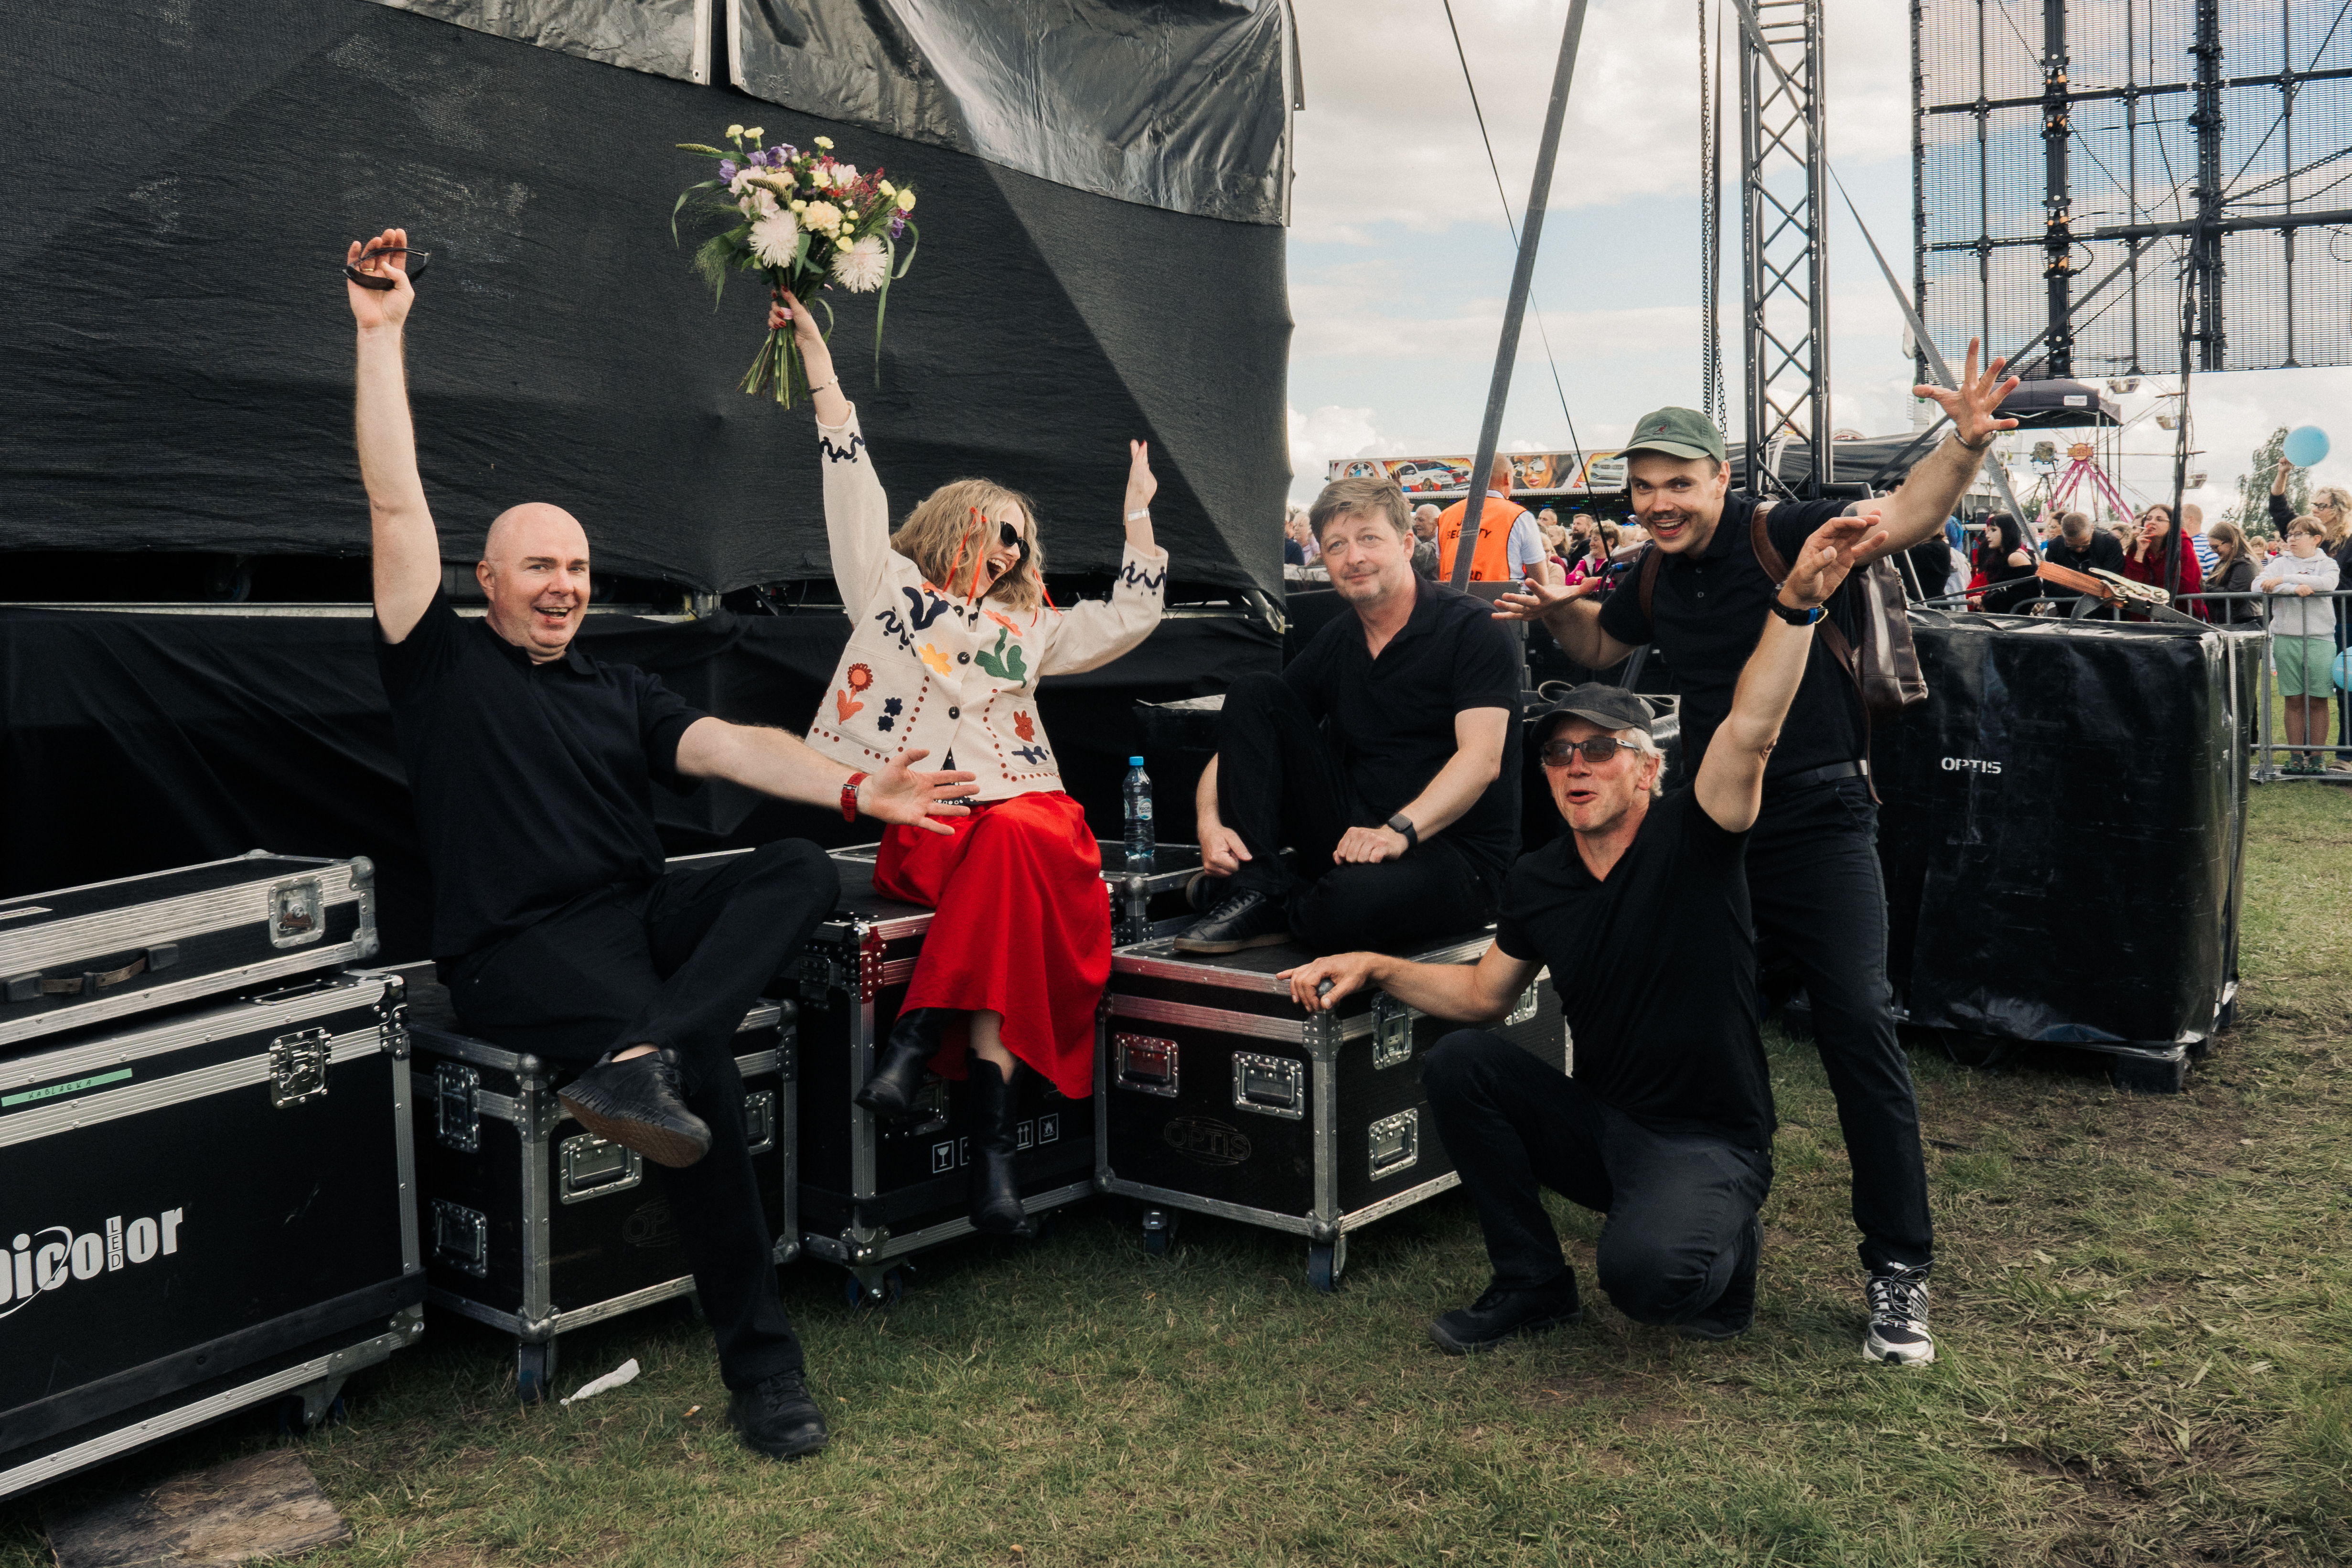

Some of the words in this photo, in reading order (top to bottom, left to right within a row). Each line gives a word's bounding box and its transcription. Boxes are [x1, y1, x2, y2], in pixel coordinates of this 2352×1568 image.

[1350, 463, 1374, 474] BMW
[1941, 757, 2001, 774] OPTIS
[1167, 1123, 1248, 1159] OPTIS
